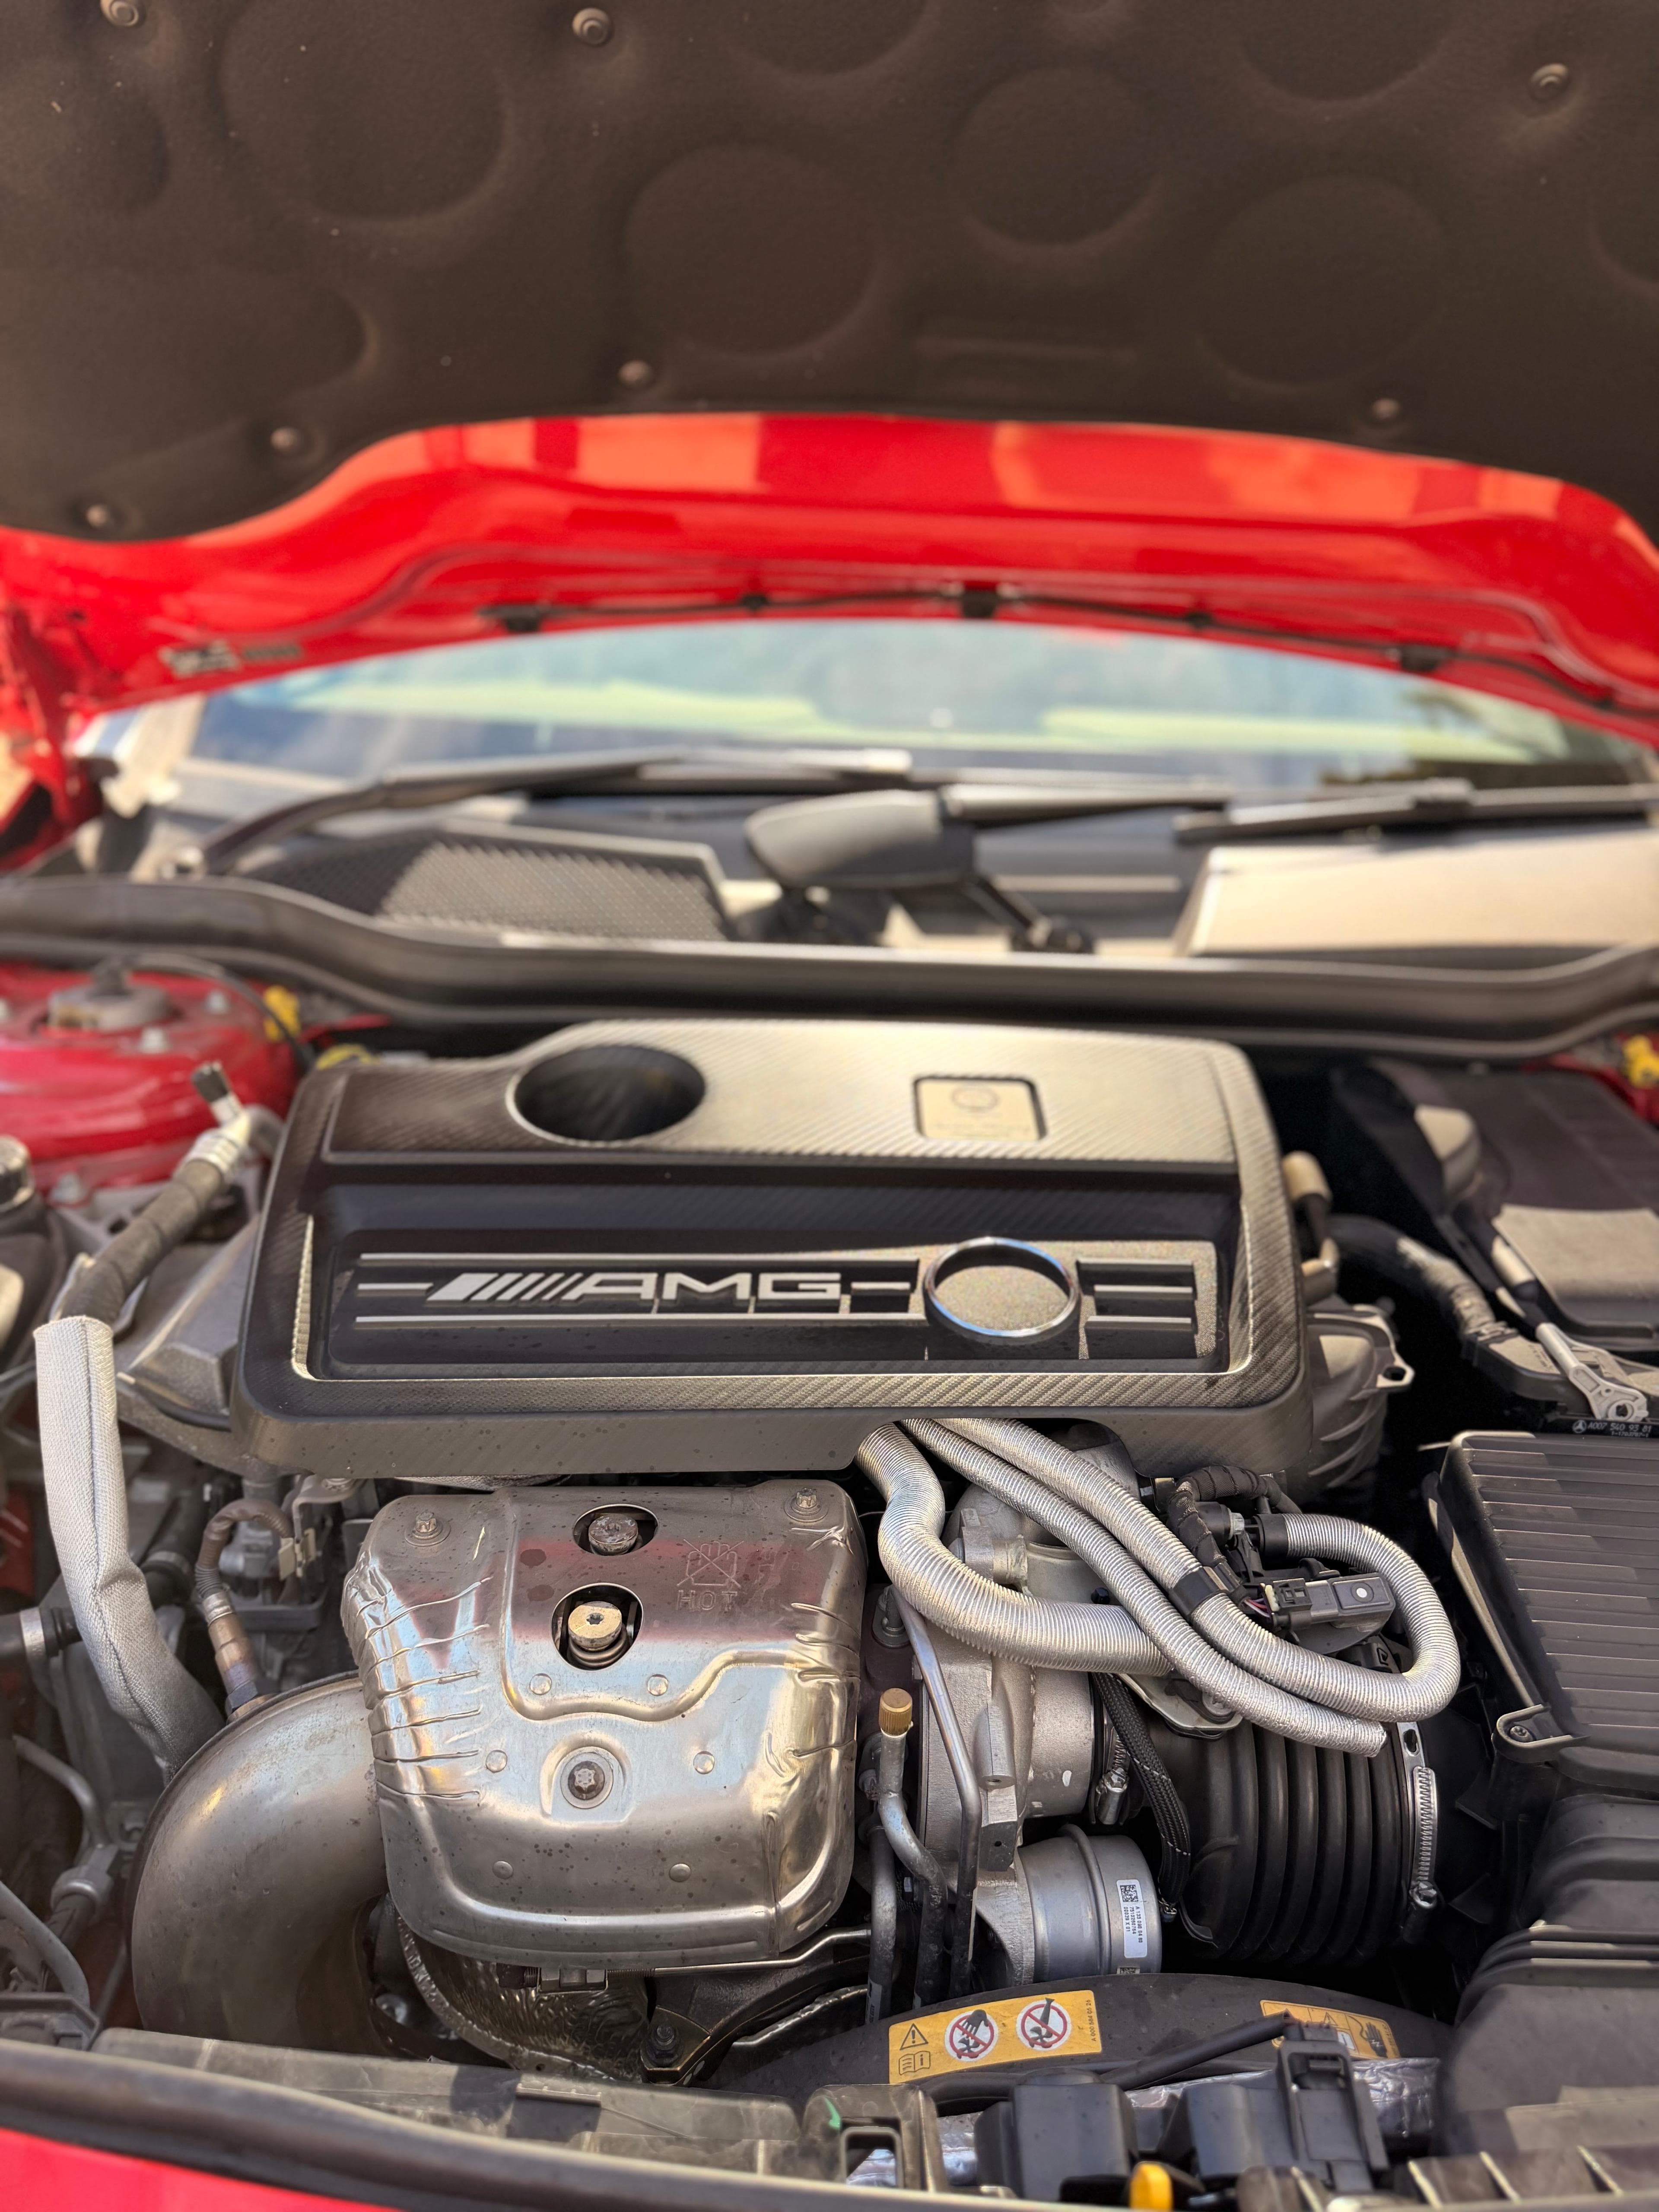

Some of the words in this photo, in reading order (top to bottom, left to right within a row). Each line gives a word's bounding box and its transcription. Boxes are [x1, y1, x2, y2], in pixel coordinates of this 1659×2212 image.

[562, 1272, 841, 1300] AMG
[1610, 1423, 1625, 1431] 540
[677, 1590, 738, 1611] HOT
